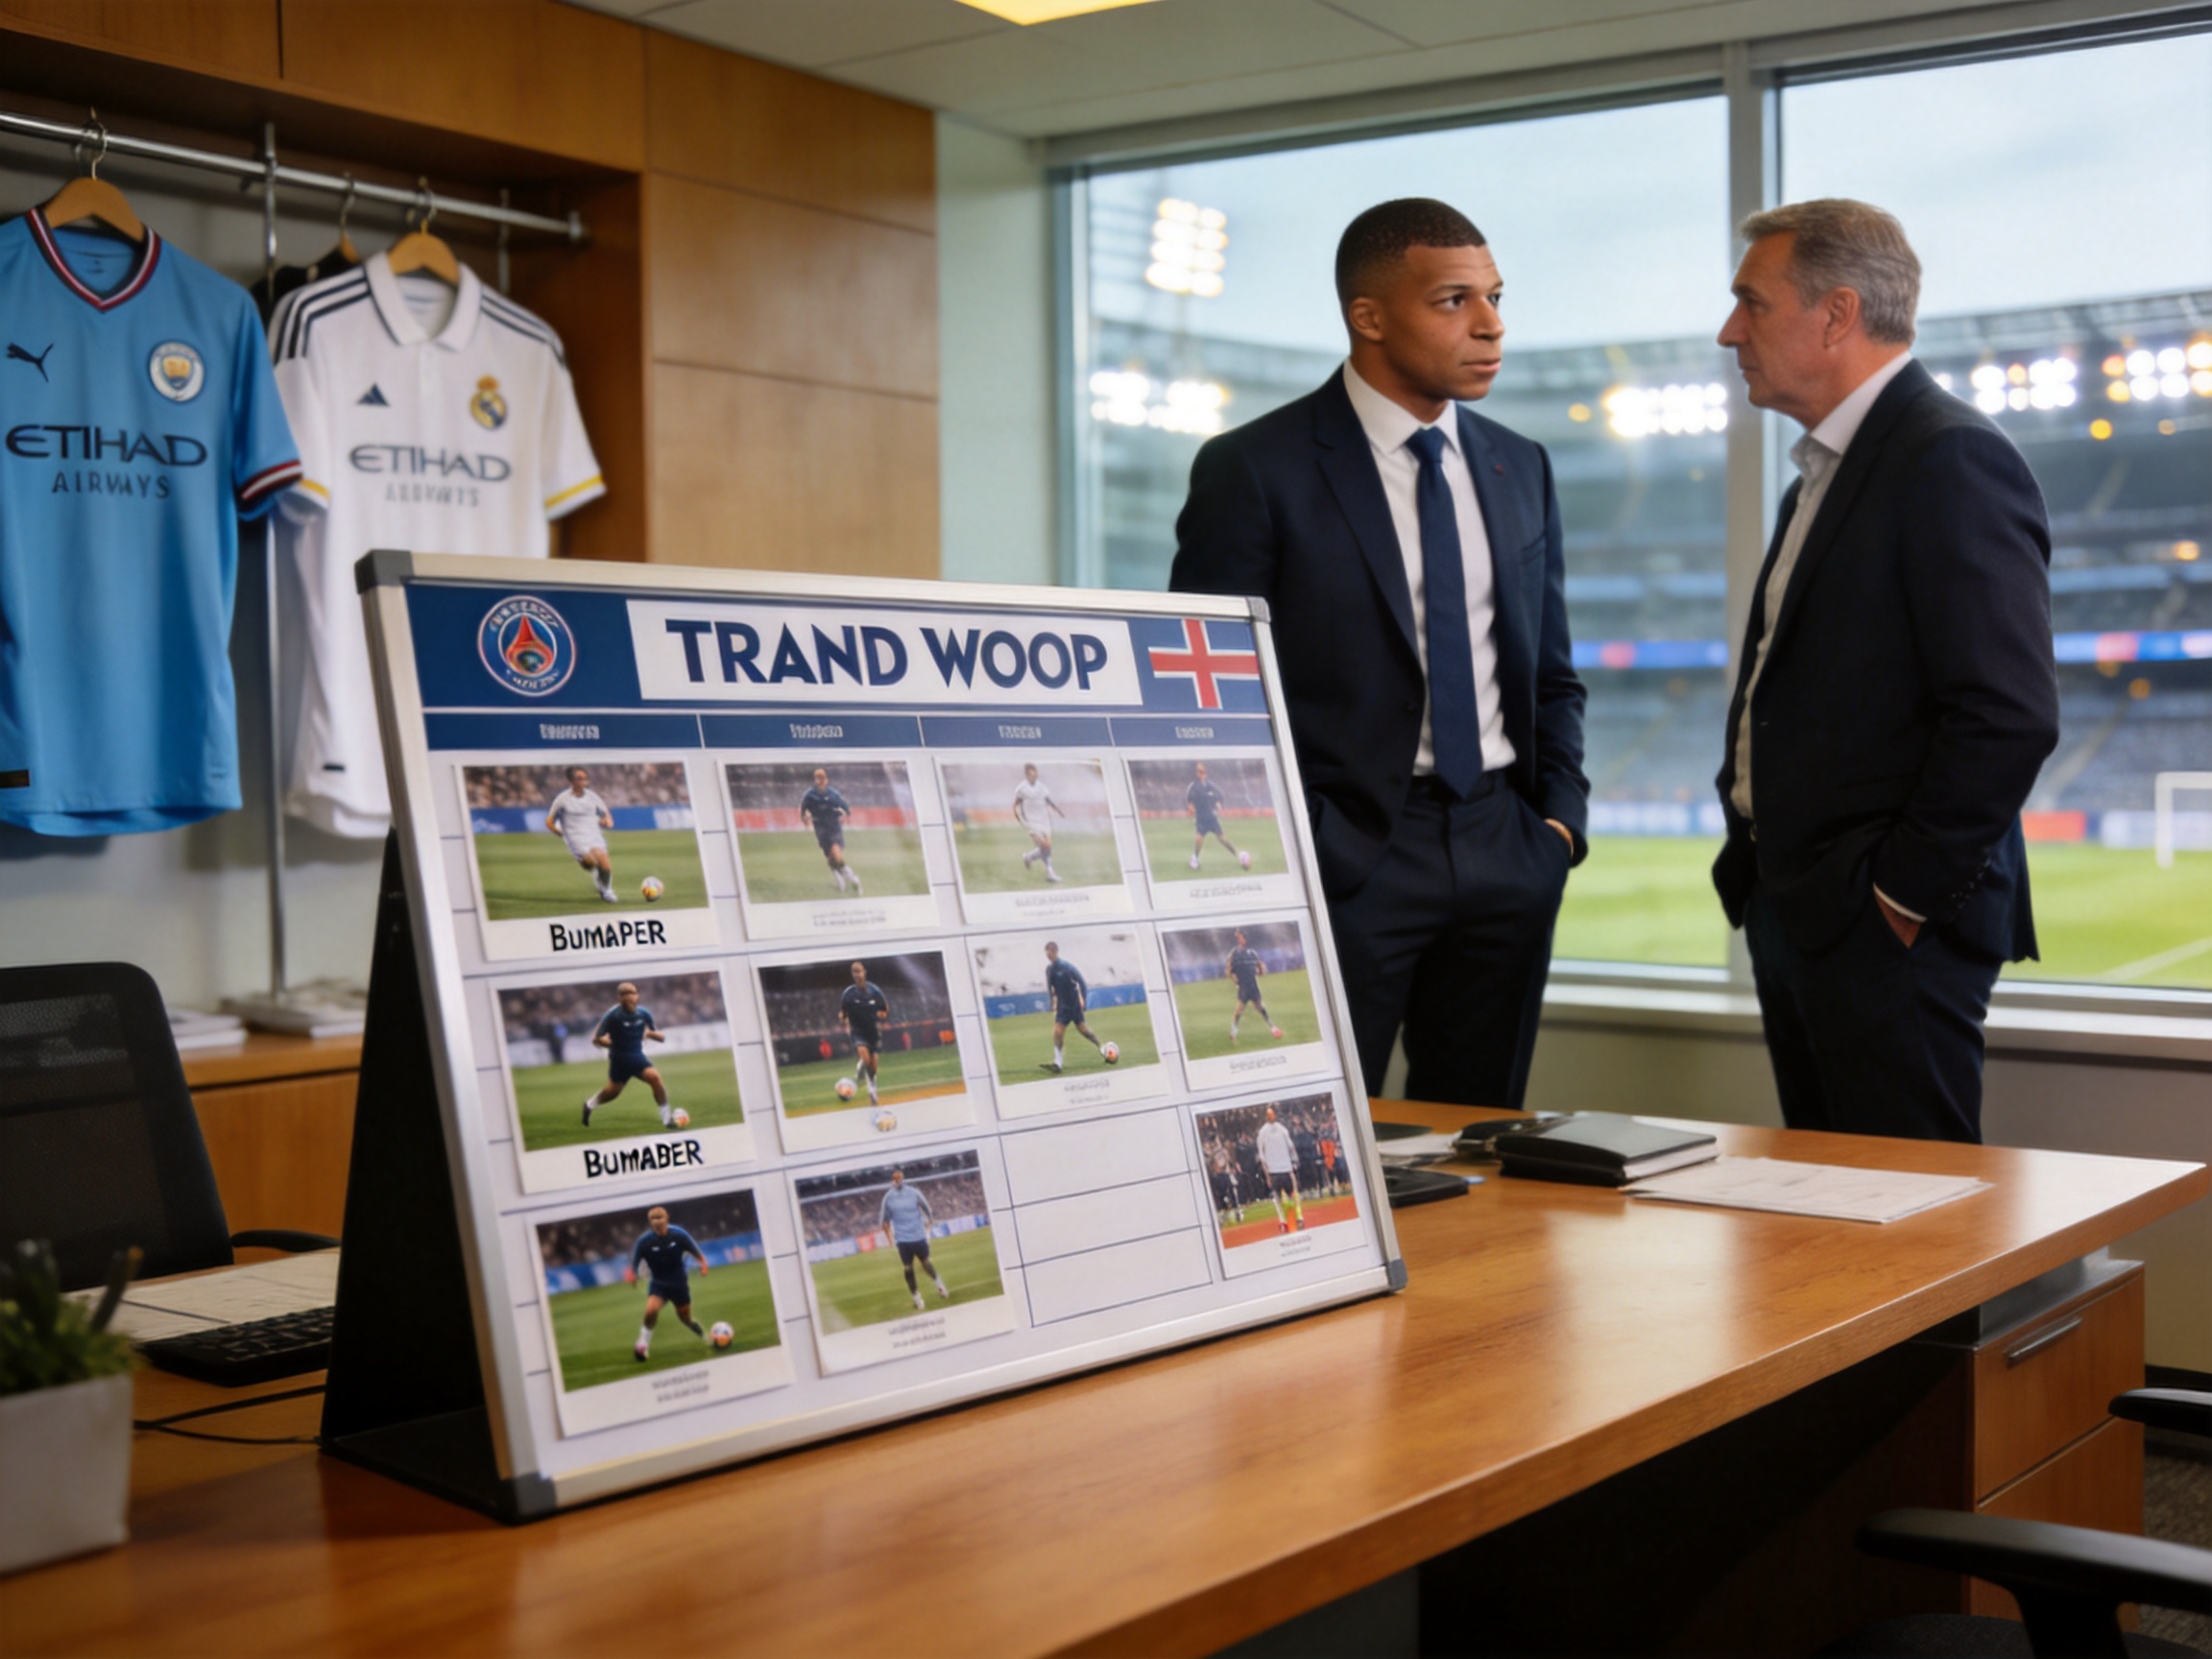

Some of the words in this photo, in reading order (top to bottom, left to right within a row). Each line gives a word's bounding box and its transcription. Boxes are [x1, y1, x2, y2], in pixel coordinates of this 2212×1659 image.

[6, 424, 207, 467] ETIHAD
[349, 444, 512, 482] ETIHAD
[52, 469, 171, 499] AIRWAYS
[664, 618, 908, 686] TRAND
[919, 627, 1108, 690] WOOP
[549, 920, 667, 951] BUMAPER
